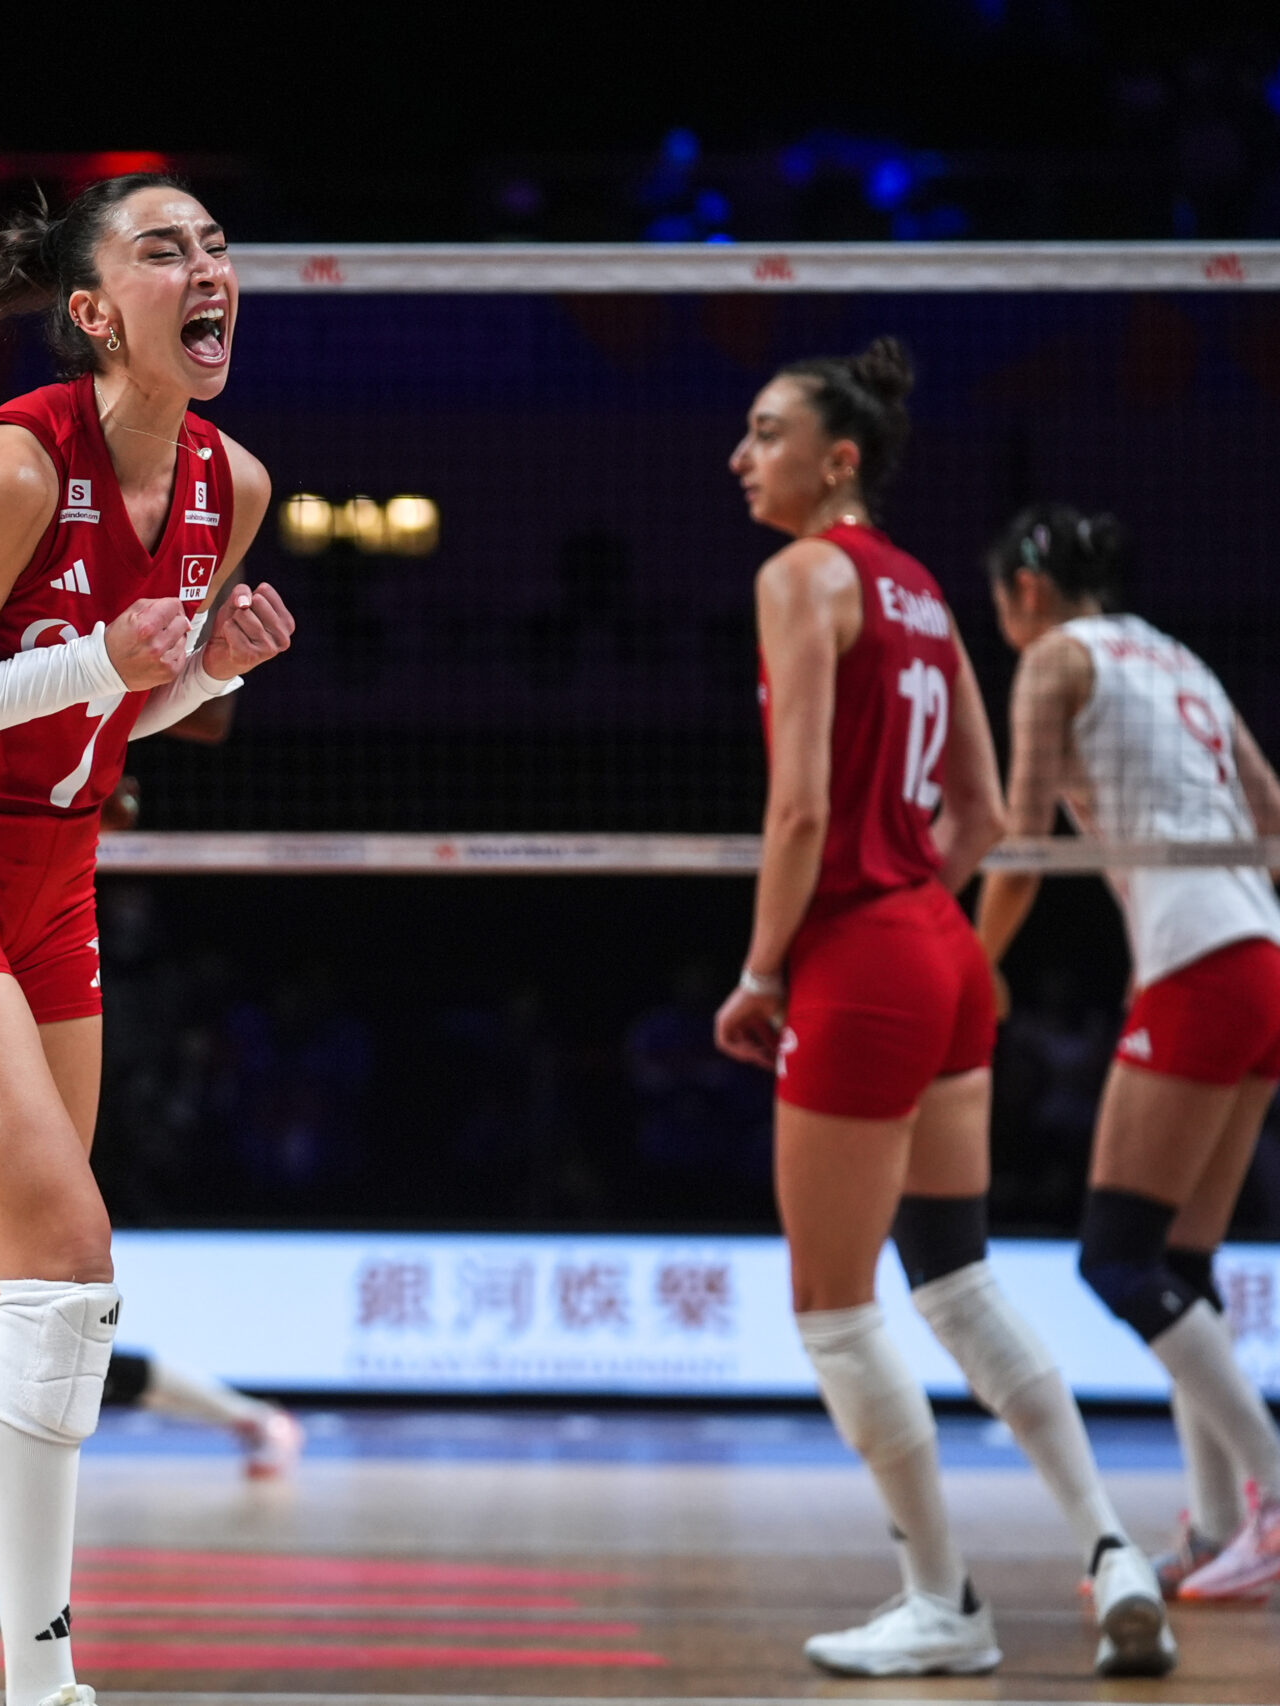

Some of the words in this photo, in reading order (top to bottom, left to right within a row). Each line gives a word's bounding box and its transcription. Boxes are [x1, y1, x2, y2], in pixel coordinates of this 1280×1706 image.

[71, 484, 85, 501] S
[198, 487, 204, 503] S
[185, 588, 201, 598] TUR
[49, 692, 127, 809] 7
[899, 658, 948, 810] 12
[1176, 690, 1227, 784] 9
